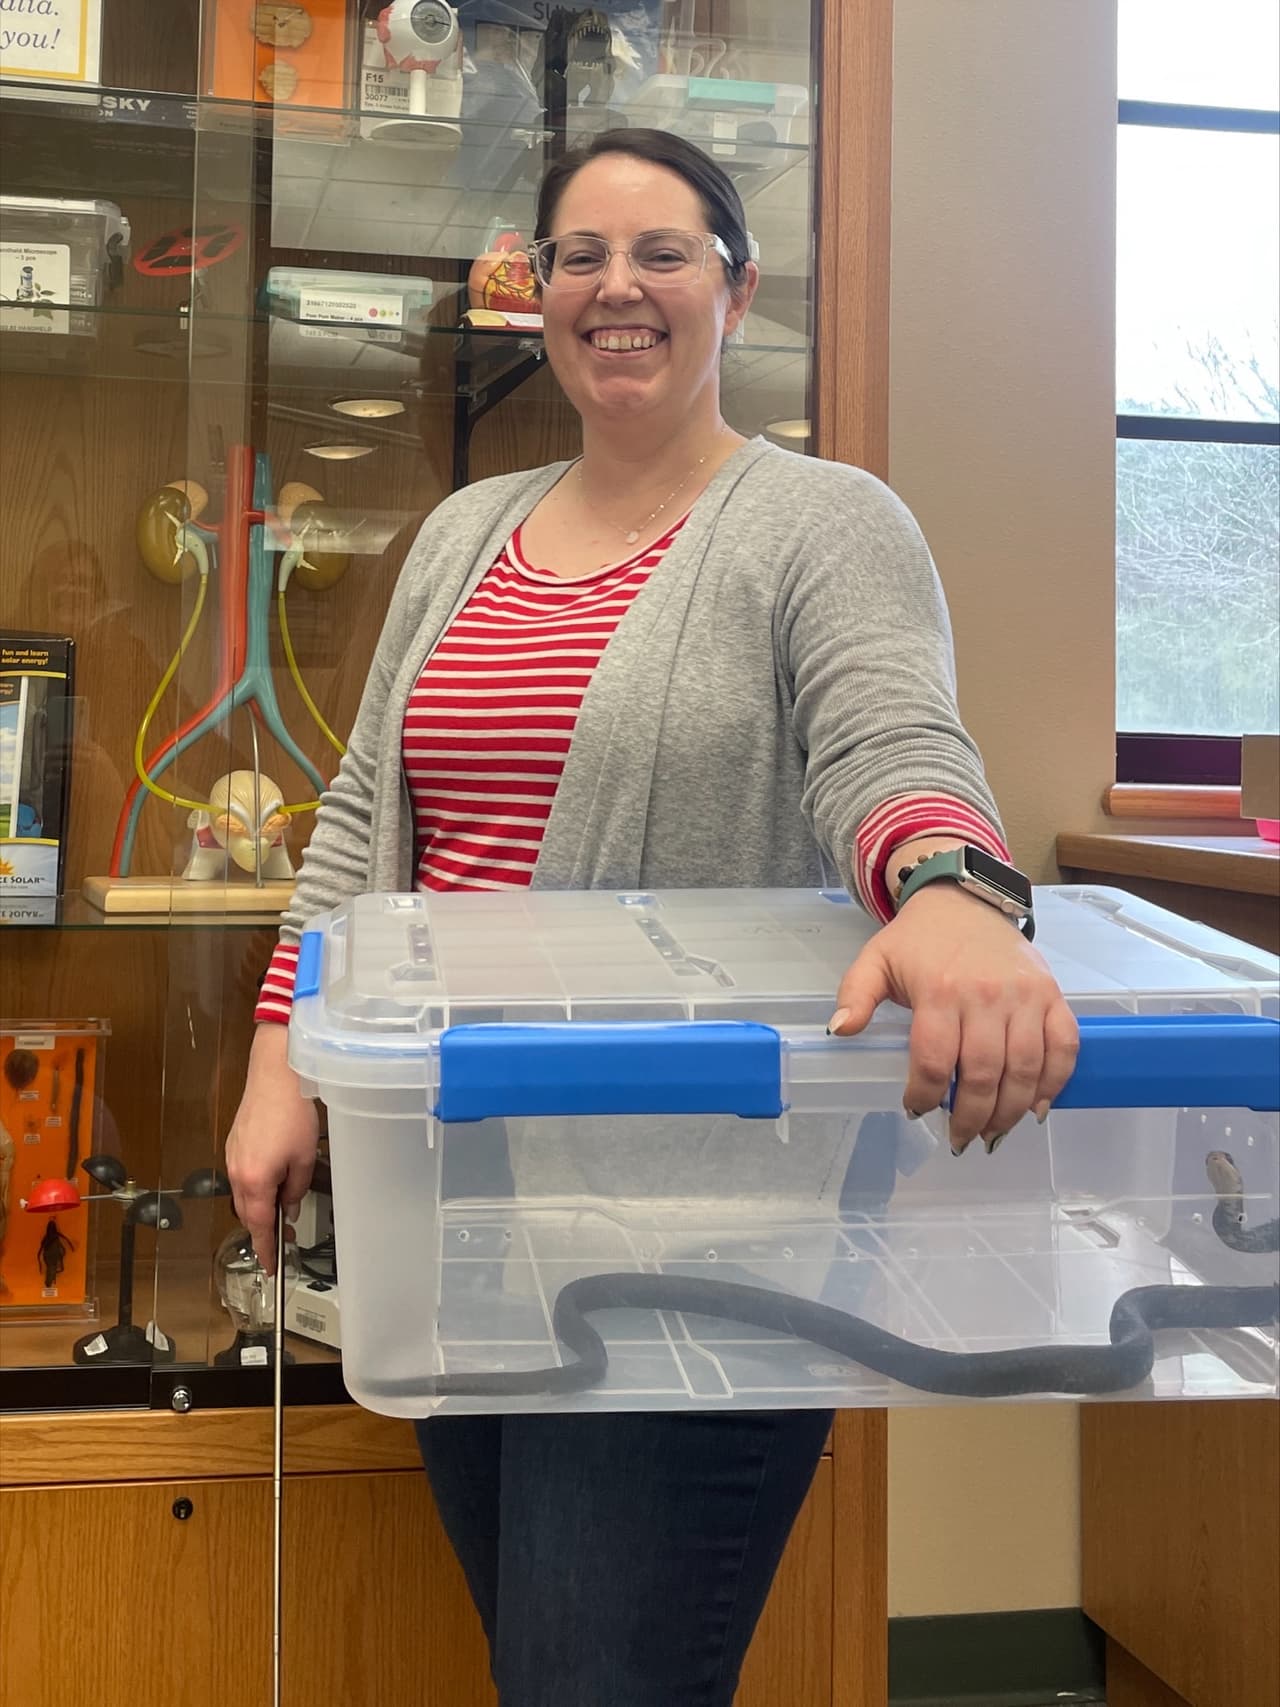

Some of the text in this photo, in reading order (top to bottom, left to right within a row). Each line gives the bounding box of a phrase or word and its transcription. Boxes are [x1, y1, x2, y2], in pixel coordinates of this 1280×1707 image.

[0, 28, 61, 50] you!
[366, 72, 385, 83] F15
[102, 95, 151, 112] SKY
[30, 649, 49, 657] learn
